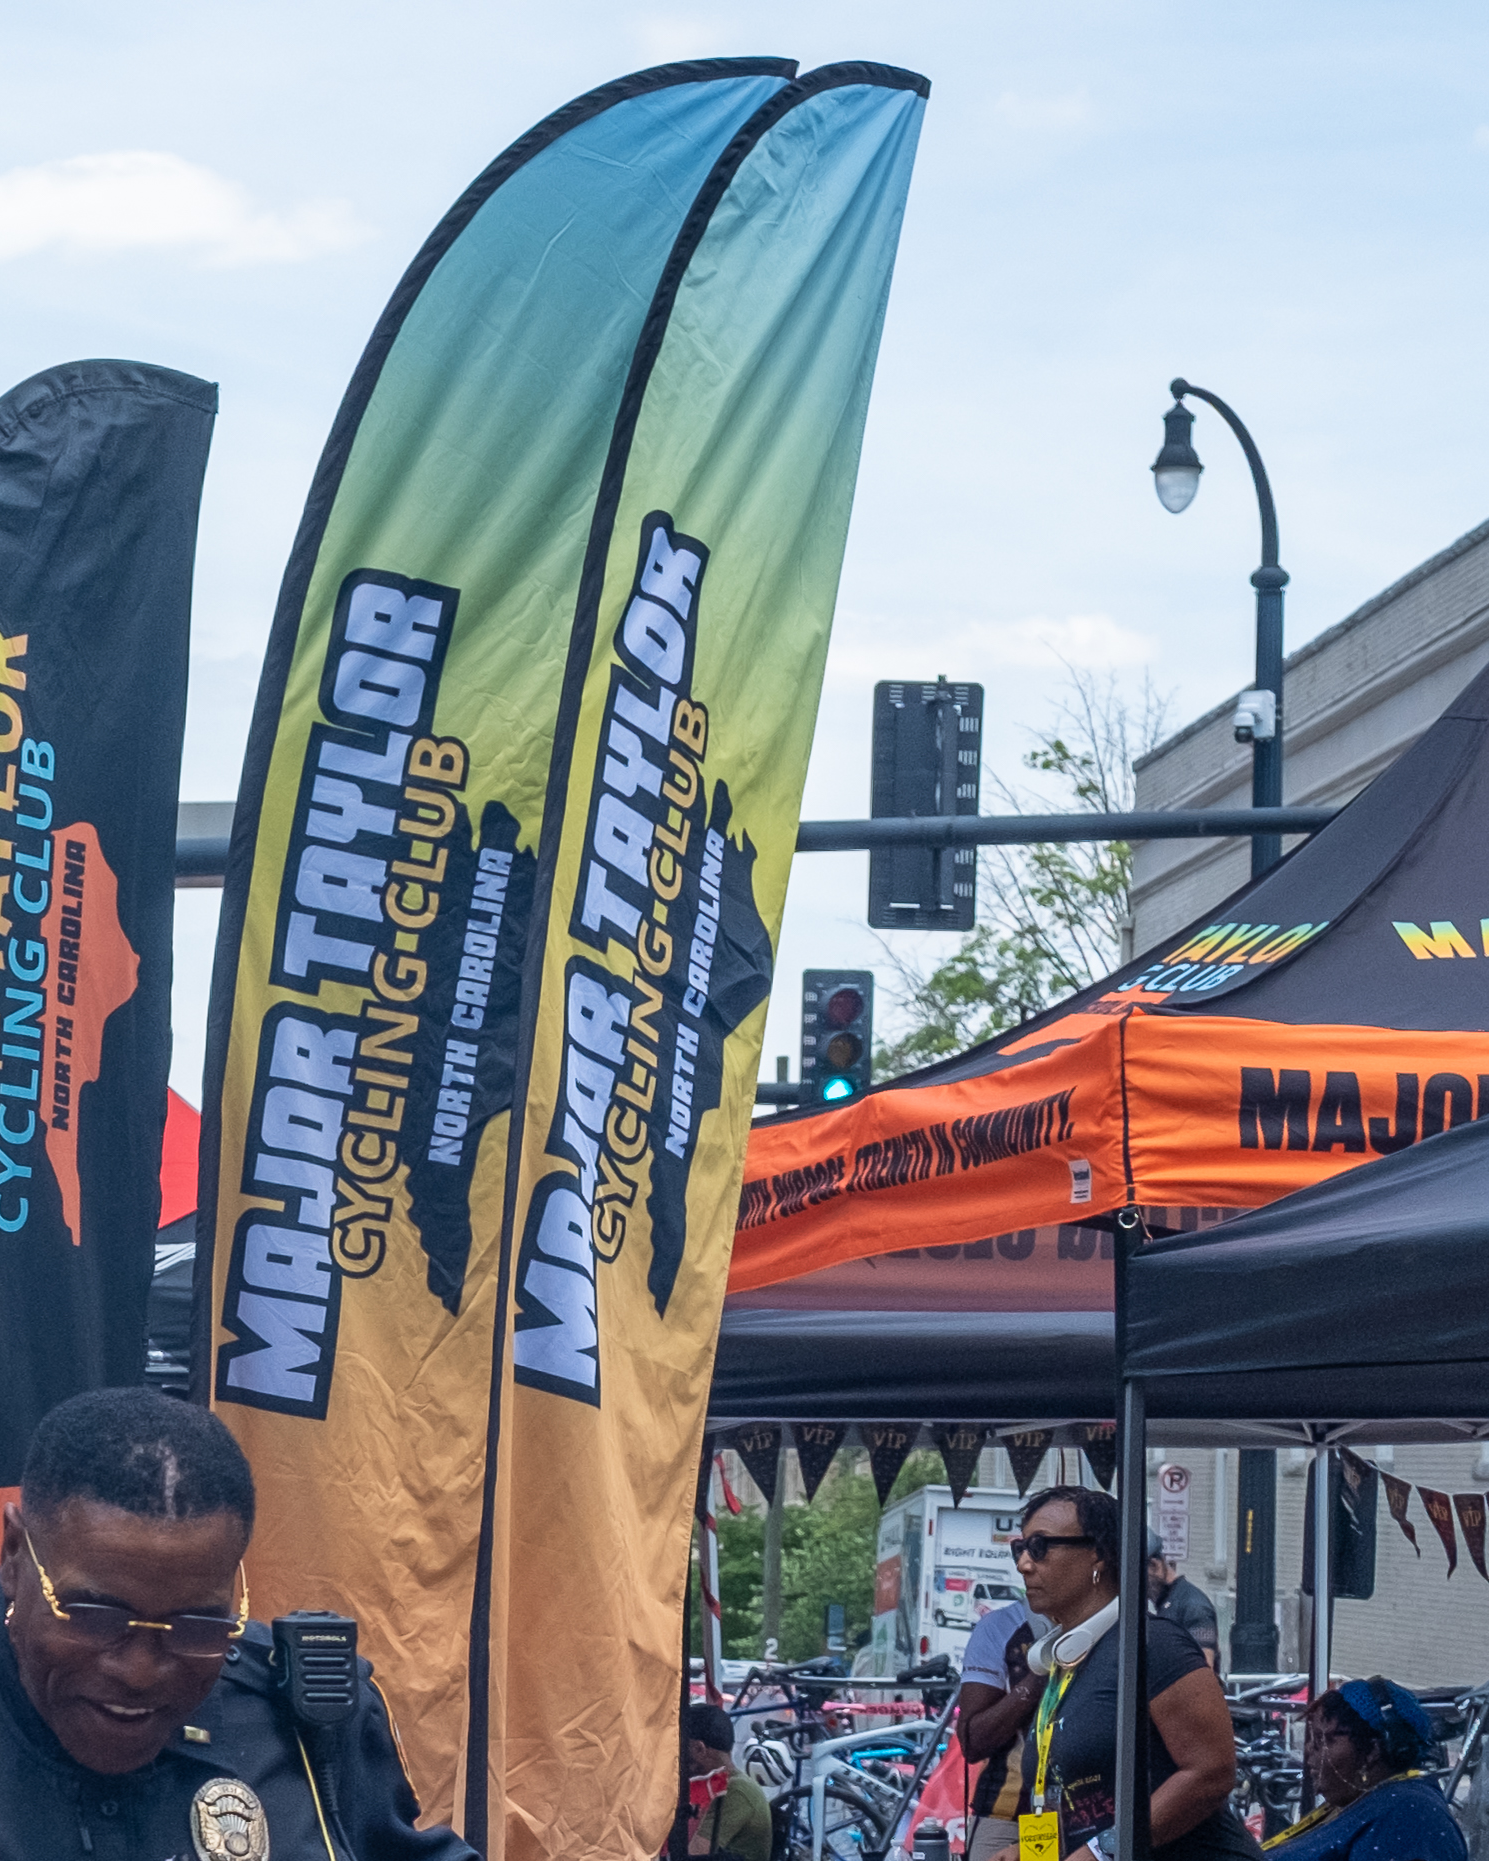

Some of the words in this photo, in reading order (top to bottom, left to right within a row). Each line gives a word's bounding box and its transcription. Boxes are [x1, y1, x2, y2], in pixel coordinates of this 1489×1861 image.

[13, 738, 56, 923] CLUB
[283, 582, 443, 986] TAYLOR
[58, 841, 87, 1005] CAROLINA
[334, 951, 429, 1276] CYCLING
[382, 738, 468, 931] CLUB
[427, 1040, 479, 1168] NORTH
[454, 847, 514, 1031] CAROLINA
[514, 971, 631, 1390] MAJOR
[581, 526, 702, 942] TAYLOR
[594, 922, 674, 1263] CYCLING
[649, 700, 706, 902] CLUB
[664, 1023, 698, 1160] NORTH
[683, 827, 725, 1016] CAROLINA
[1144, 963, 1245, 992] CLUB
[1391, 918, 1489, 960] M
[52, 1017, 74, 1130] NORTH
[1238, 1066, 1489, 1156] MAJO
[226, 1016, 359, 1405] MAJOR
[802, 1427, 836, 1447] VIP
[872, 1429, 907, 1450] VIP
[764, 1637, 778, 1660] 2
